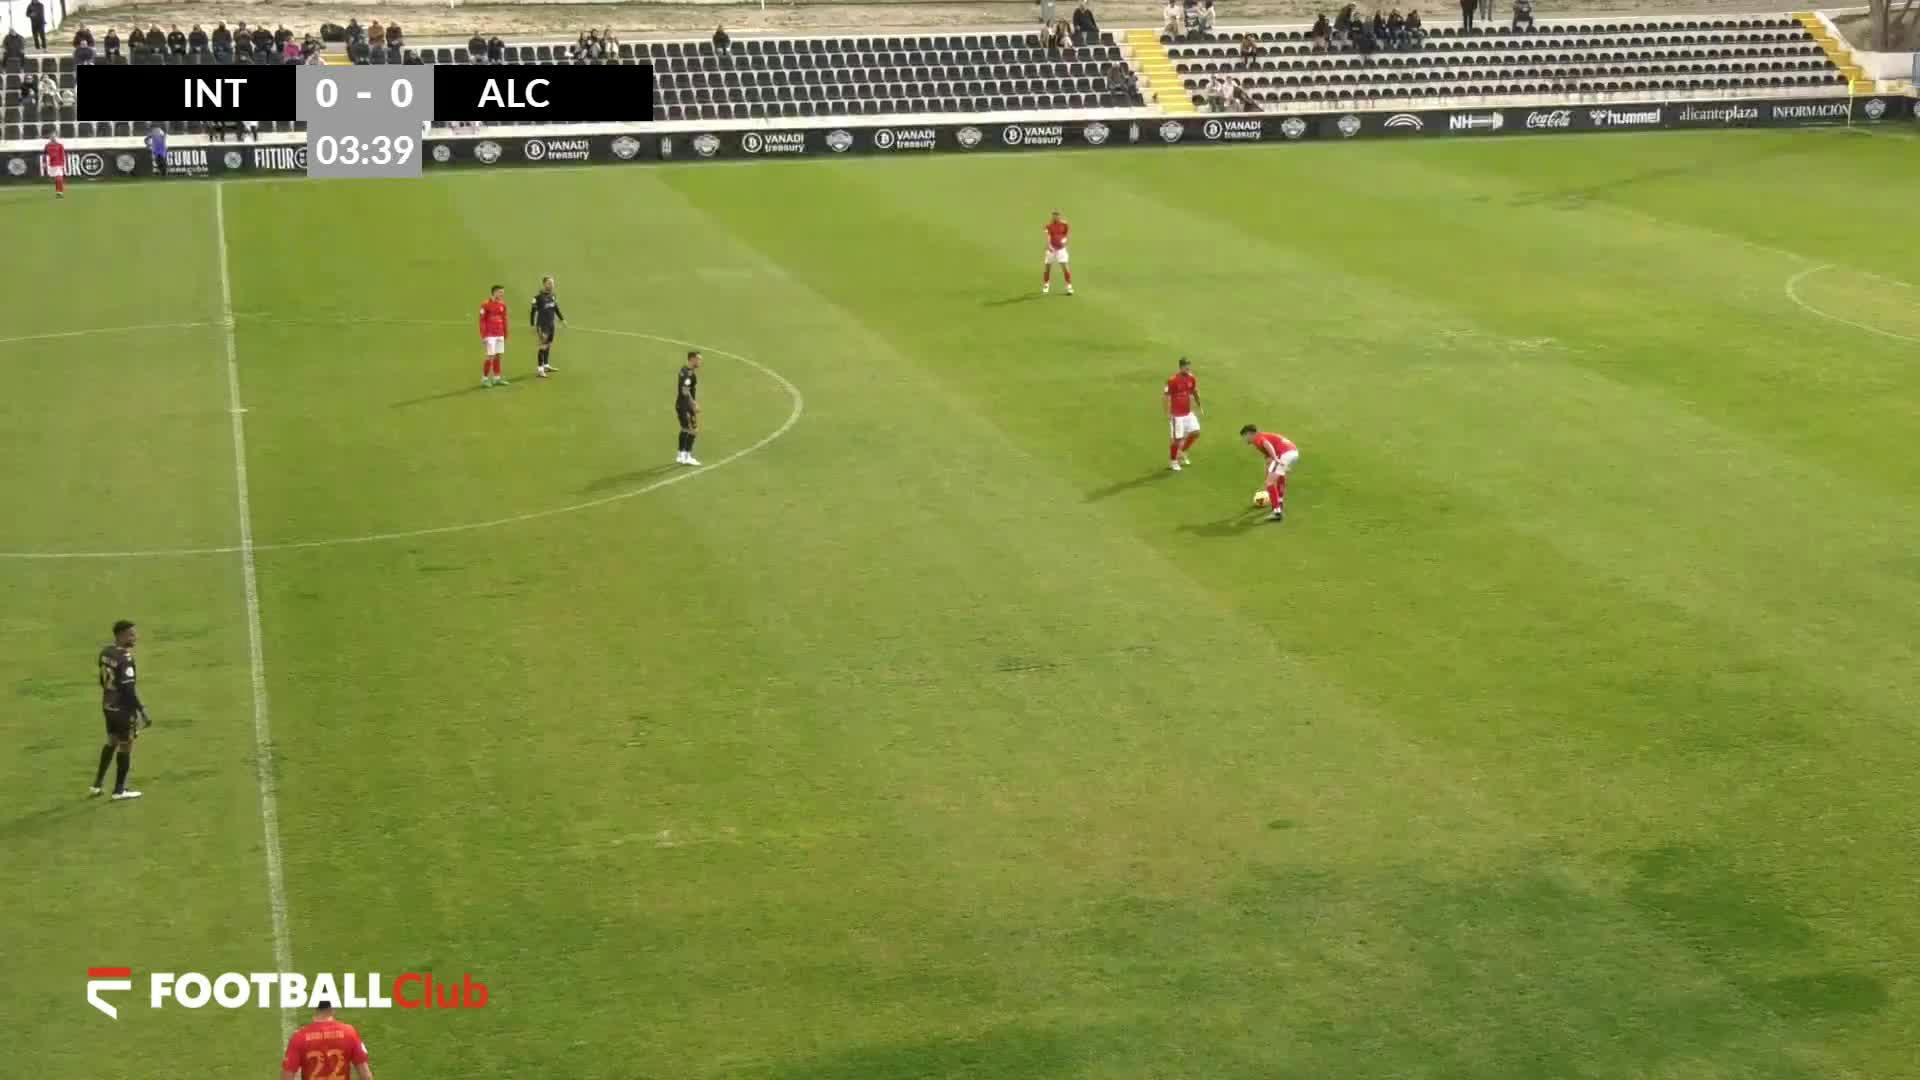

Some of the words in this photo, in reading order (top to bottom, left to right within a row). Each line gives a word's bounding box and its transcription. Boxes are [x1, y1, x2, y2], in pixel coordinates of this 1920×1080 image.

[1607, 108, 1661, 125] hummel
[1679, 104, 1758, 123] alicanteplaza
[1224, 121, 1261, 130] VANADI
[896, 129, 936, 139] VANADI
[1024, 126, 1063, 136] VANADI
[764, 133, 804, 143] VANADI
[547, 140, 589, 150] VANADI
[306, 1049, 344, 1080] 22
